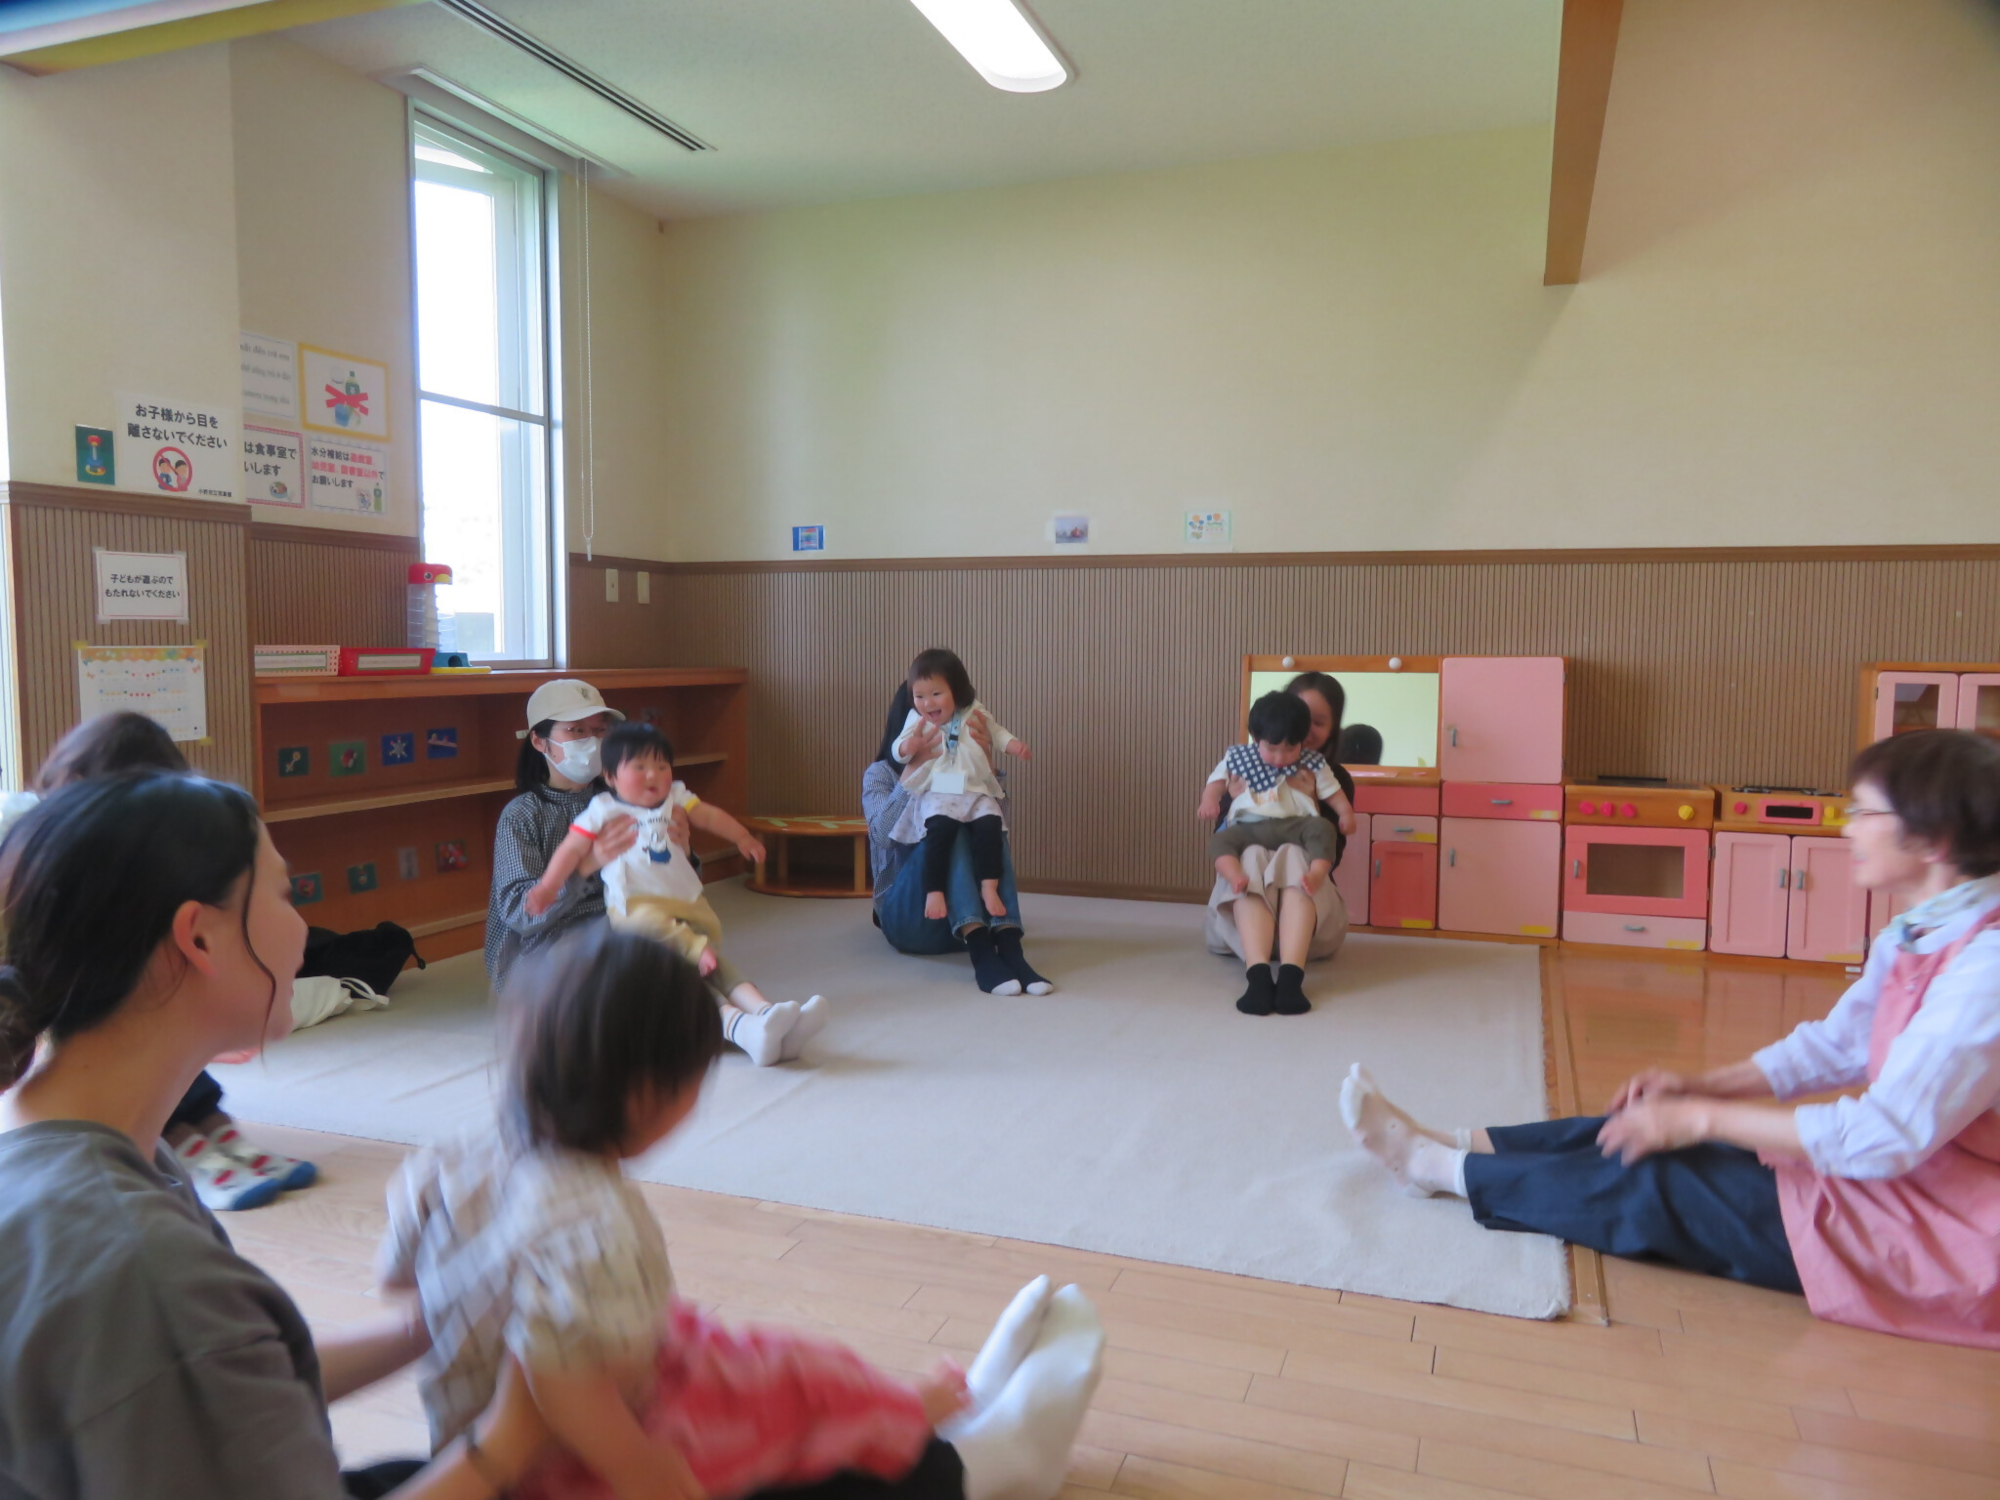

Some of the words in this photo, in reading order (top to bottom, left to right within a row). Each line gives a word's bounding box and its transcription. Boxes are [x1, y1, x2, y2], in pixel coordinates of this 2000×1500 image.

[135, 404, 218, 429] お子様から目を
[127, 423, 227, 448] 離さないでください
[244, 441, 297, 460] は食事室で
[244, 461, 281, 476] いします
[312, 475, 354, 488] お願いします
[110, 573, 174, 585] 子どもが遊ぶので
[105, 588, 180, 599] もたれないでください
